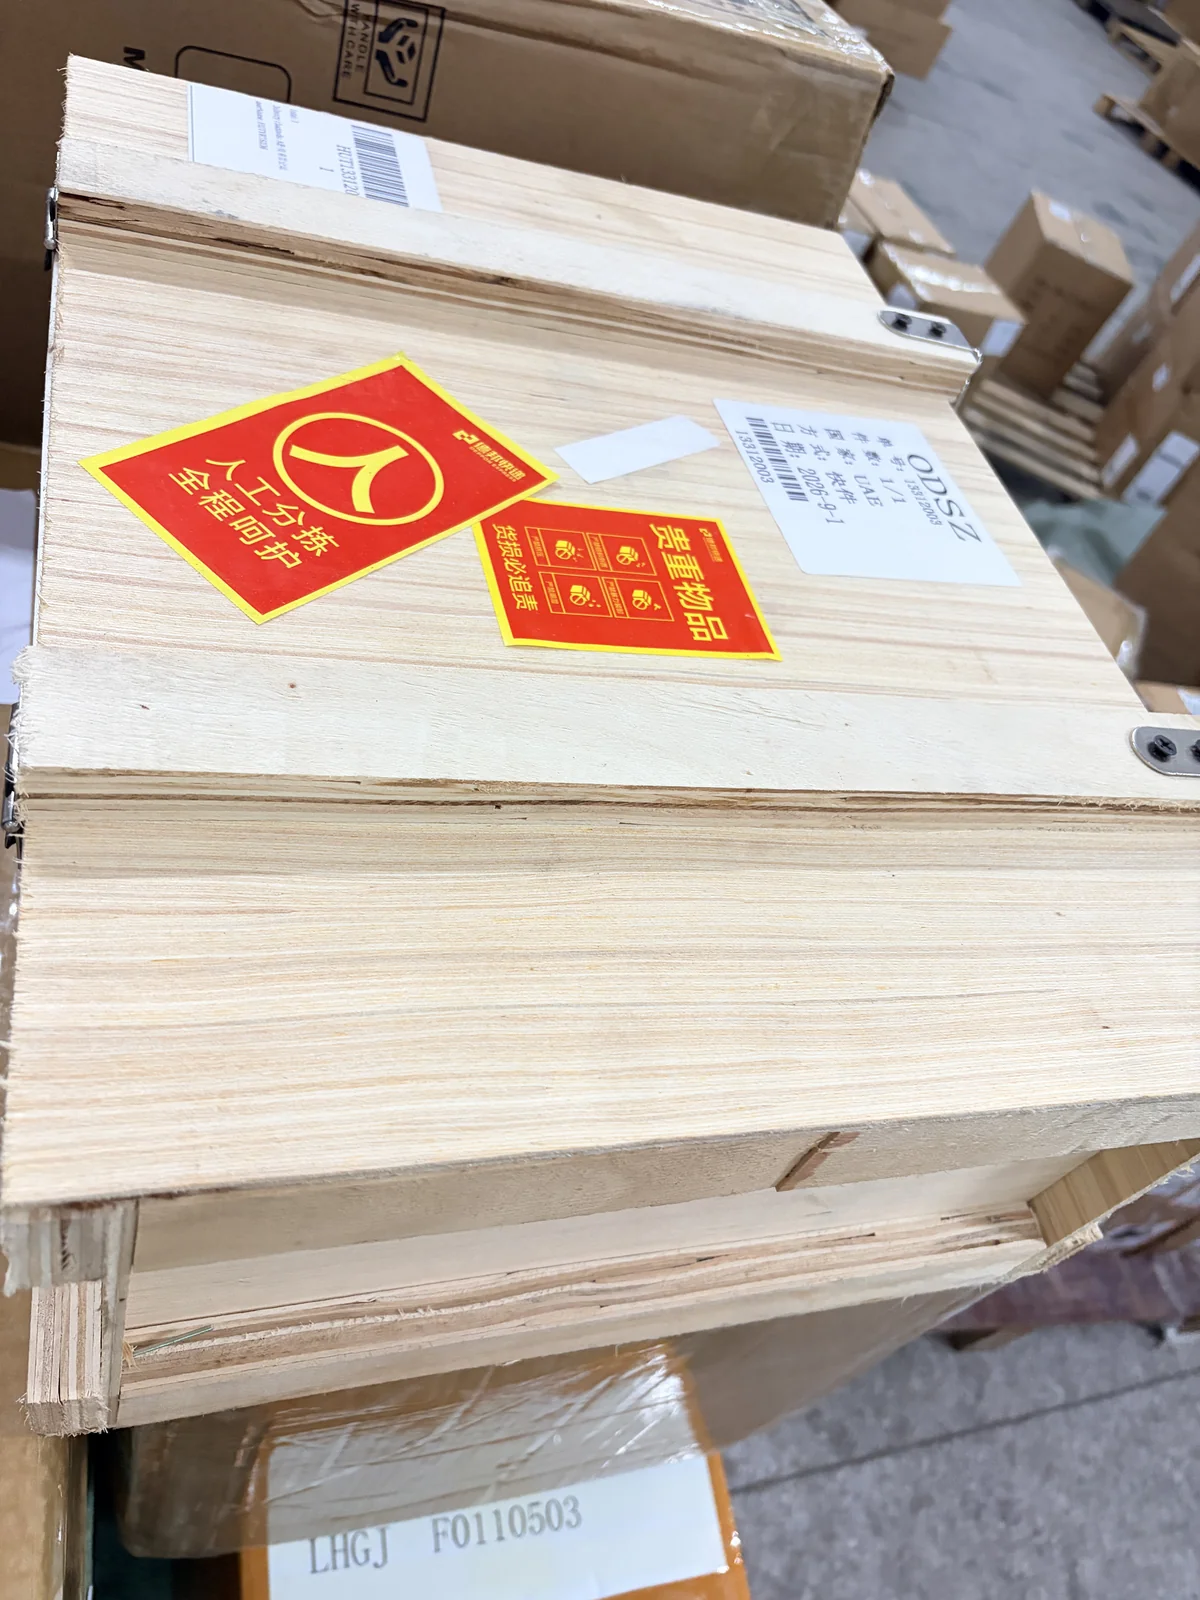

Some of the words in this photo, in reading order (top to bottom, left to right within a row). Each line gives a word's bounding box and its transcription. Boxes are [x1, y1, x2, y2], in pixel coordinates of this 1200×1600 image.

[341, 40, 356, 79] CARE
[473, 441, 527, 481] 德邦快递
[735, 430, 775, 483] 13312003
[205, 458, 340, 557] 人工分拣
[797, 467, 846, 524] 2026-9-1
[825, 471, 857, 504] 快件
[854, 475, 884, 507] UAE
[879, 477, 907, 503] 1/1
[904, 479, 943, 526] 13312003
[907, 454, 982, 543] ODSZ
[168, 466, 302, 569] 全程呵护
[492, 524, 539, 611] 货损必追责
[649, 523, 729, 642] 贵重物品
[307, 1526, 391, 1575] LHGJ
[431, 1494, 583, 1553] F0110503
